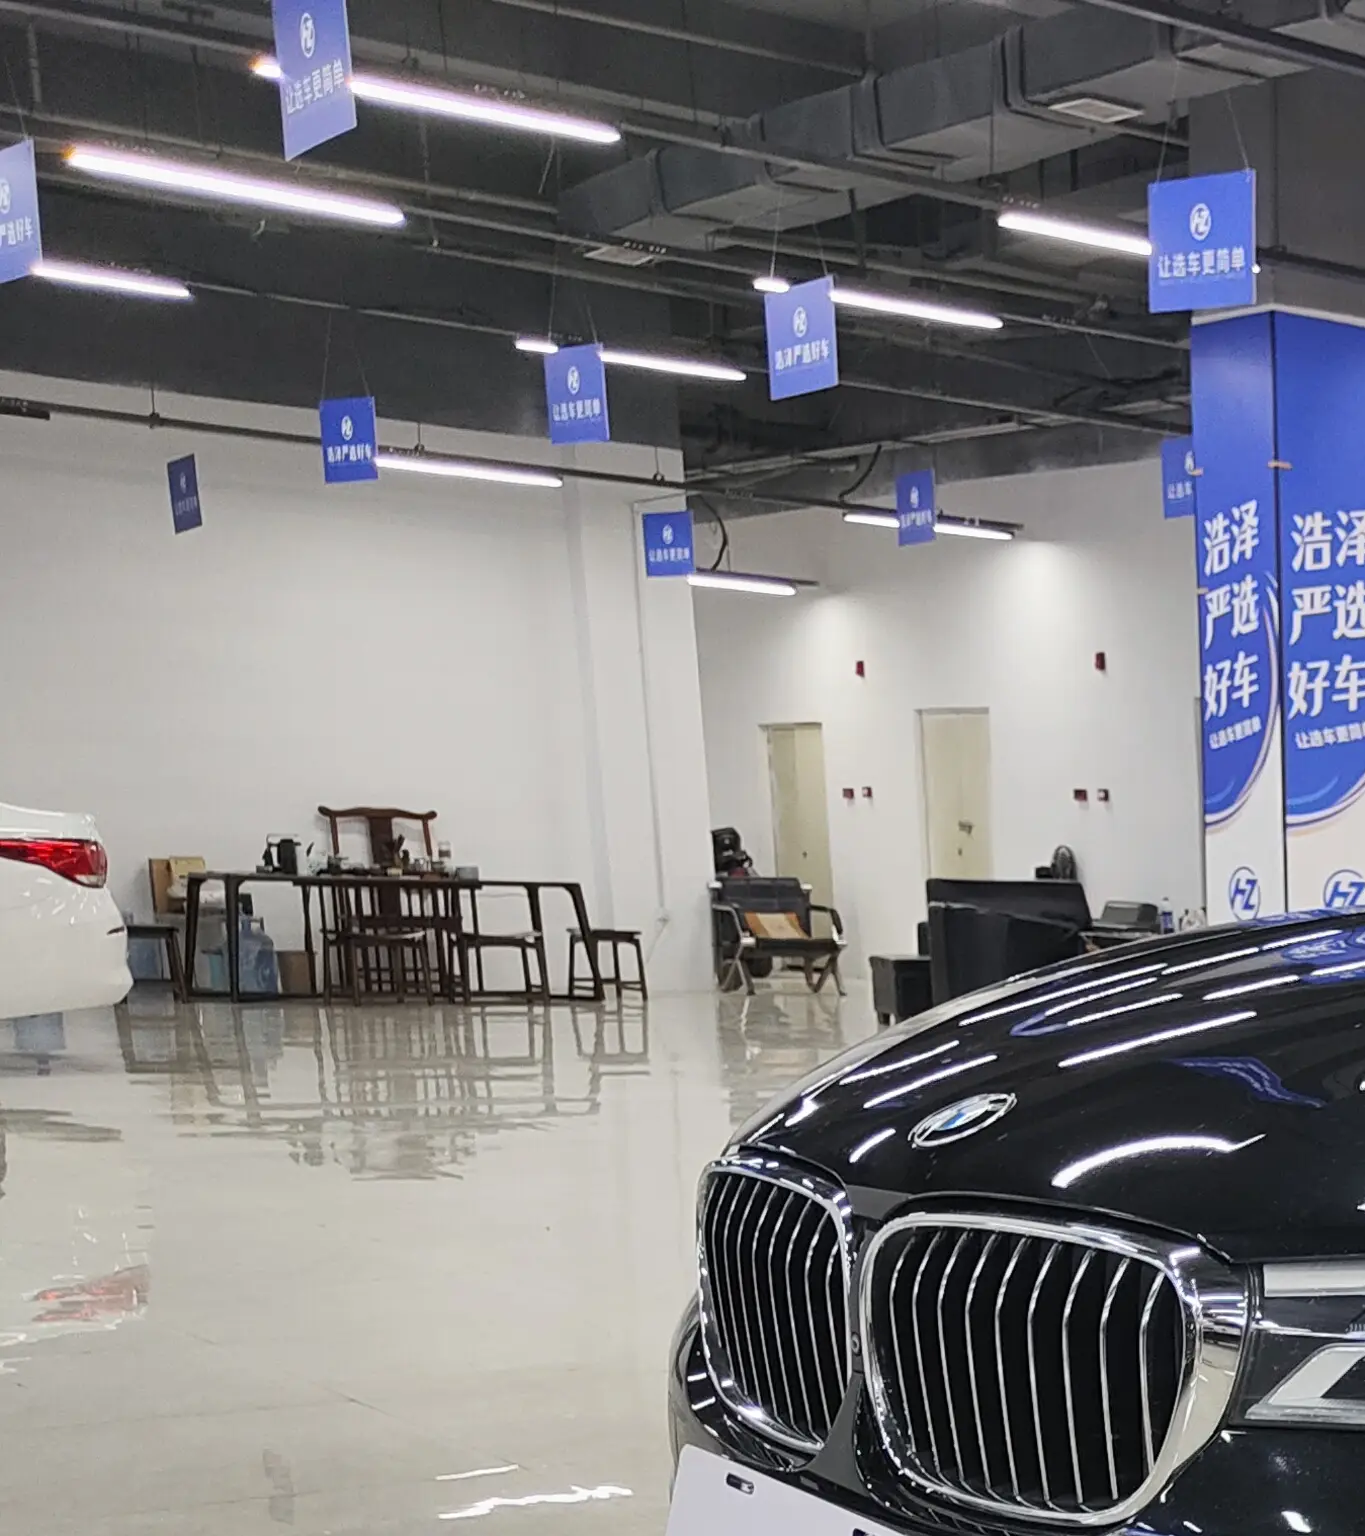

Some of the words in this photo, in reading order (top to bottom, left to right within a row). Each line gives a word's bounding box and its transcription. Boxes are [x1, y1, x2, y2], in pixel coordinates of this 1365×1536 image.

[285, 58, 345, 115] 让选车更简单
[1158, 246, 1245, 278] 让选车更简单
[1203, 498, 1261, 577] 浩泽
[1204, 573, 1261, 651] 严选
[1203, 650, 1261, 723] 好车
[1208, 715, 1262, 751] 让选车更简单
[1230, 877, 1260, 911] HZ
